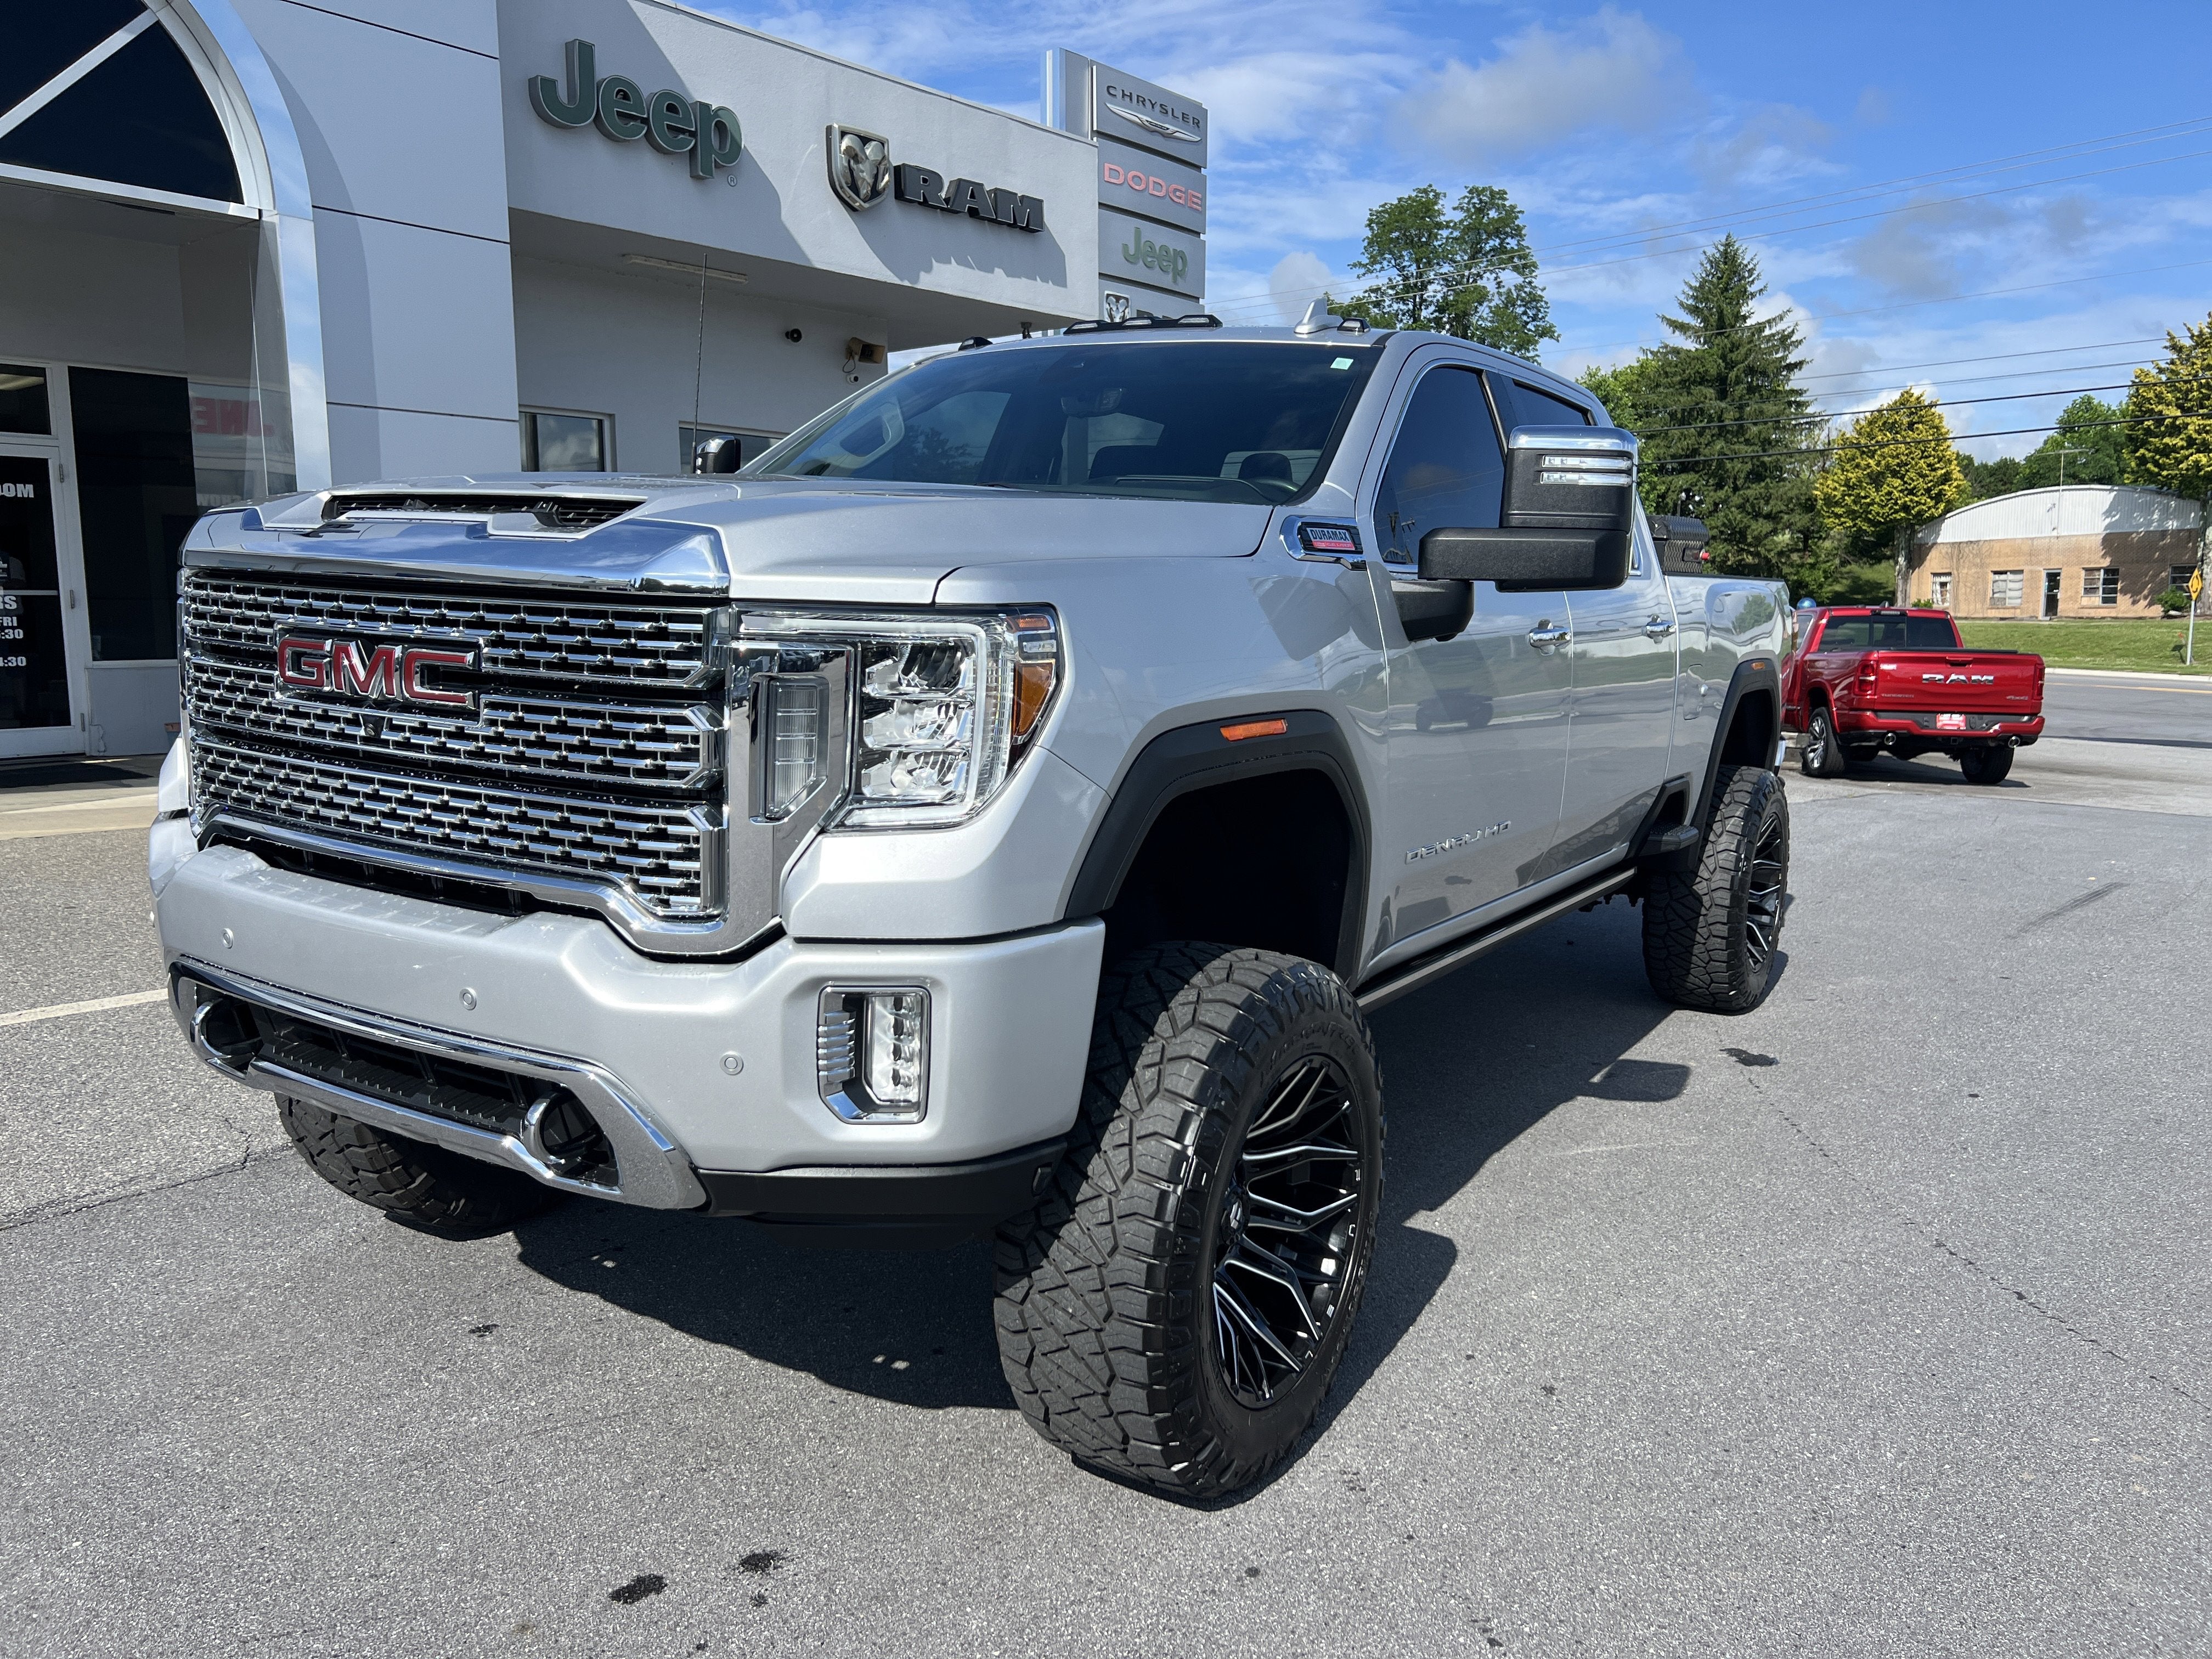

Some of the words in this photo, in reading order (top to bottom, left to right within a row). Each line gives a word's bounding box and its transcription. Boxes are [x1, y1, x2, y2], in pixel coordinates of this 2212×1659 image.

[528, 39, 743, 180] Jeep
[1105, 84, 1201, 128] CHRYSLER
[894, 163, 1045, 233] RAM
[1103, 162, 1203, 211] DODGE
[1122, 227, 1187, 283] Jeep
[0, 483, 34, 498] OM
[1310, 529, 1350, 541] DURAMAX
[0, 595, 17, 610] S
[0, 629, 24, 639] :30
[278, 637, 475, 709] GMC
[1922, 673, 1994, 685] RAM
[1404, 829, 1482, 865] DENALI
[1484, 821, 1511, 838] HD
